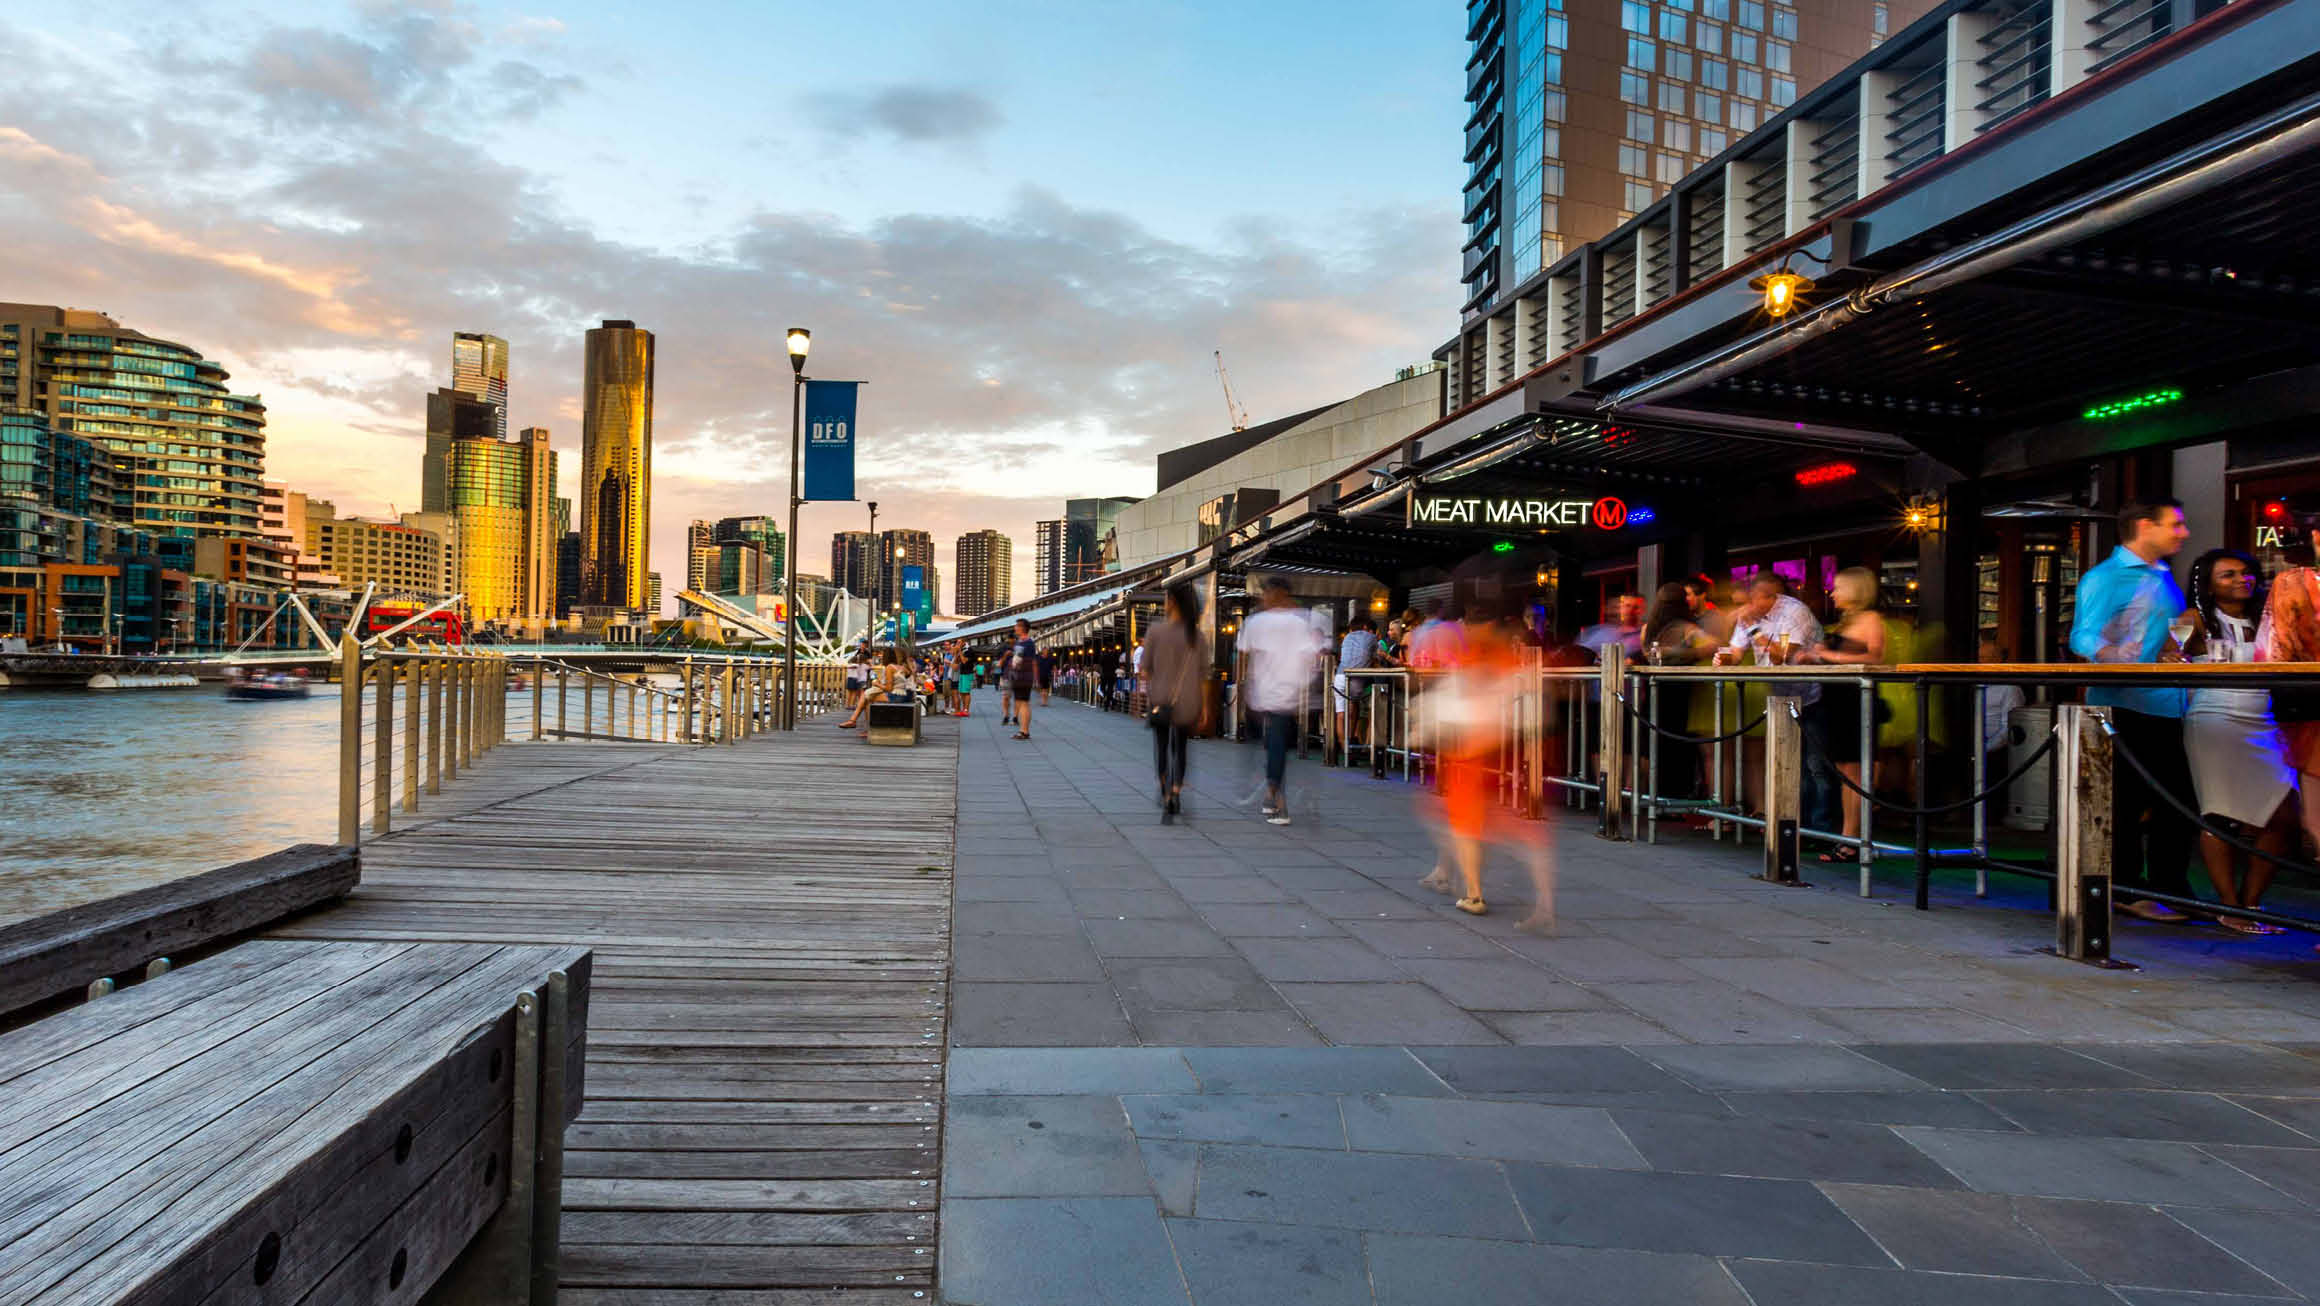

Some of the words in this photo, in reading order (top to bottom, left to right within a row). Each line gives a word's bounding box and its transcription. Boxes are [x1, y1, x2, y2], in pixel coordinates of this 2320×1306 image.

[813, 422, 847, 439] DFO
[1413, 498, 1481, 523] MEAT
[1485, 500, 1593, 525] MARKET
